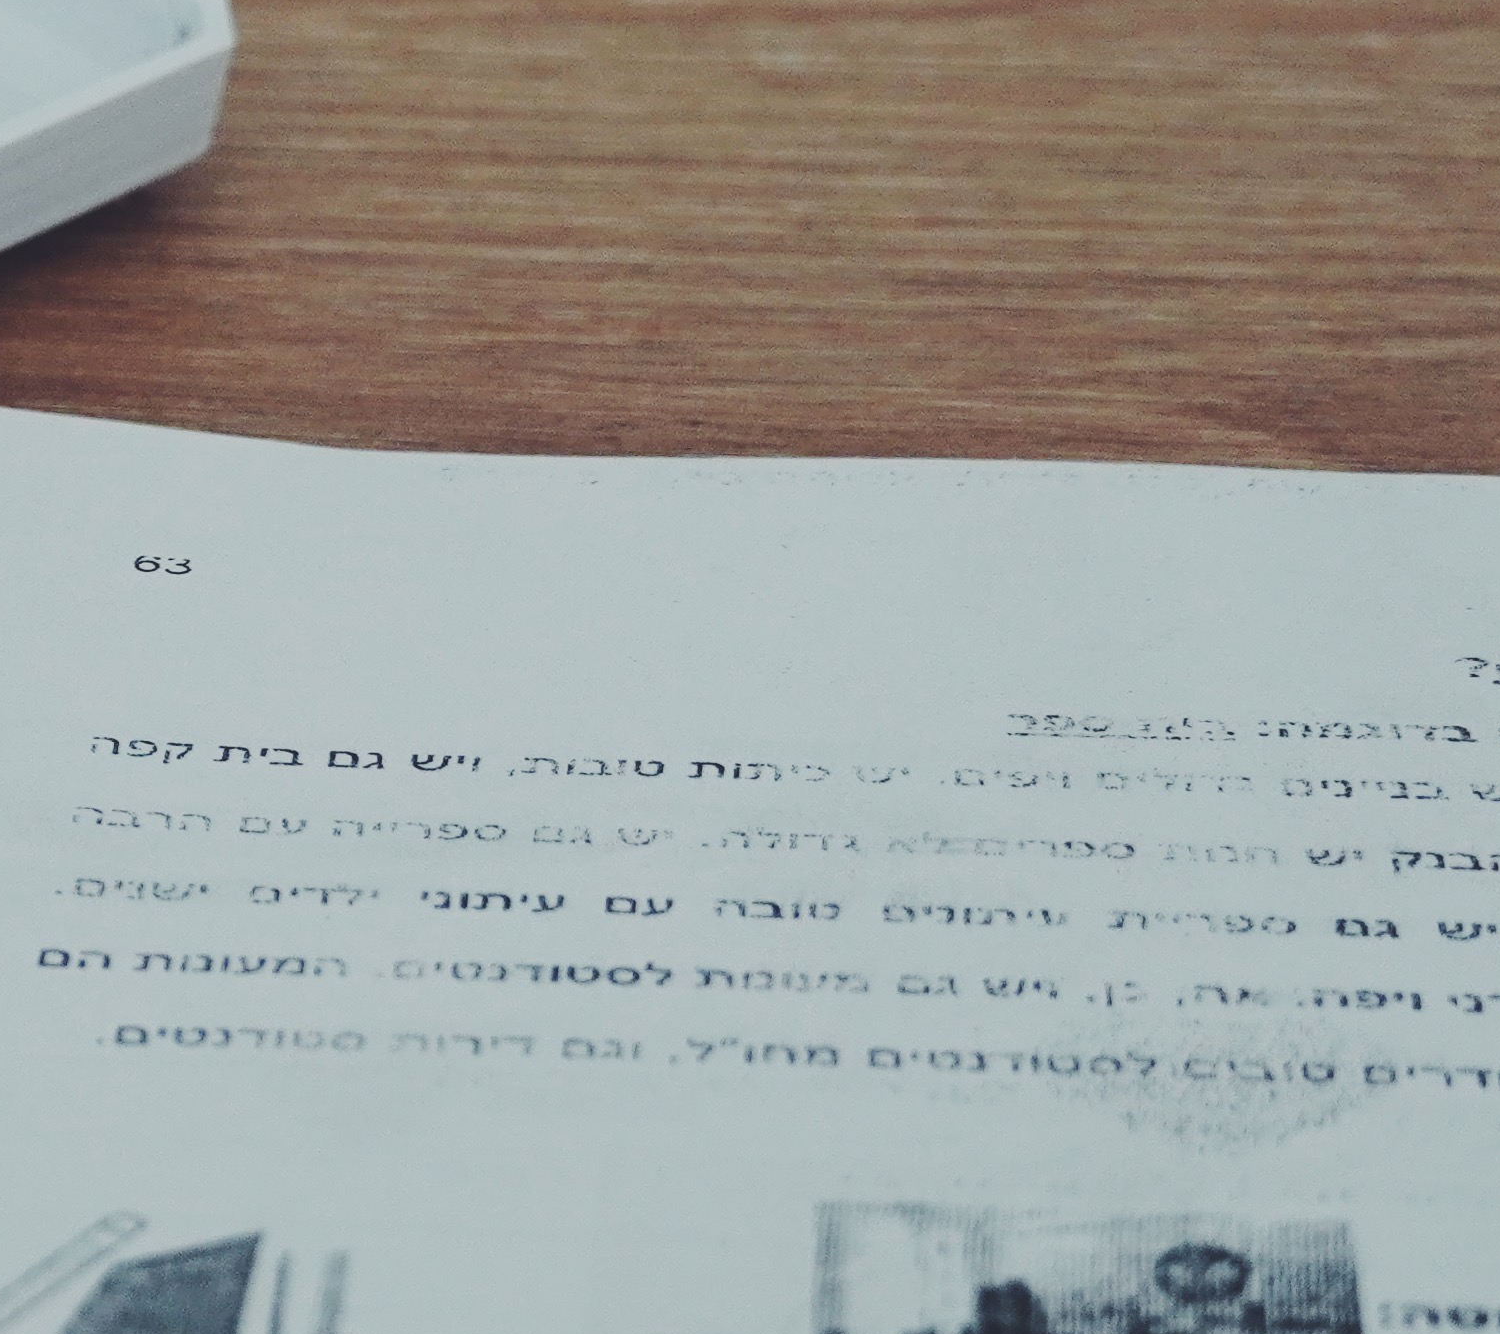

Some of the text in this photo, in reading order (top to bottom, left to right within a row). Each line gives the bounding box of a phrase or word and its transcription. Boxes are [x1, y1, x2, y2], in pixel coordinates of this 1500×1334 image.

[133, 554, 193, 576] 63
[91, 735, 195, 765] קפה
[217, 744, 303, 767] בית
[327, 749, 385, 770] גם
[410, 753, 482, 772] ויש
[71, 805, 213, 832] הרבה
[238, 815, 308, 836] עם
[332, 819, 508, 842] ספרייה
[1306, 848, 1363, 868] יש
[420, 890, 566, 914] עיתוני
[604, 895, 675, 917] עם
[1334, 917, 1400, 940] גם
[37, 948, 112, 970] הם
[135, 952, 346, 977] המעונות
